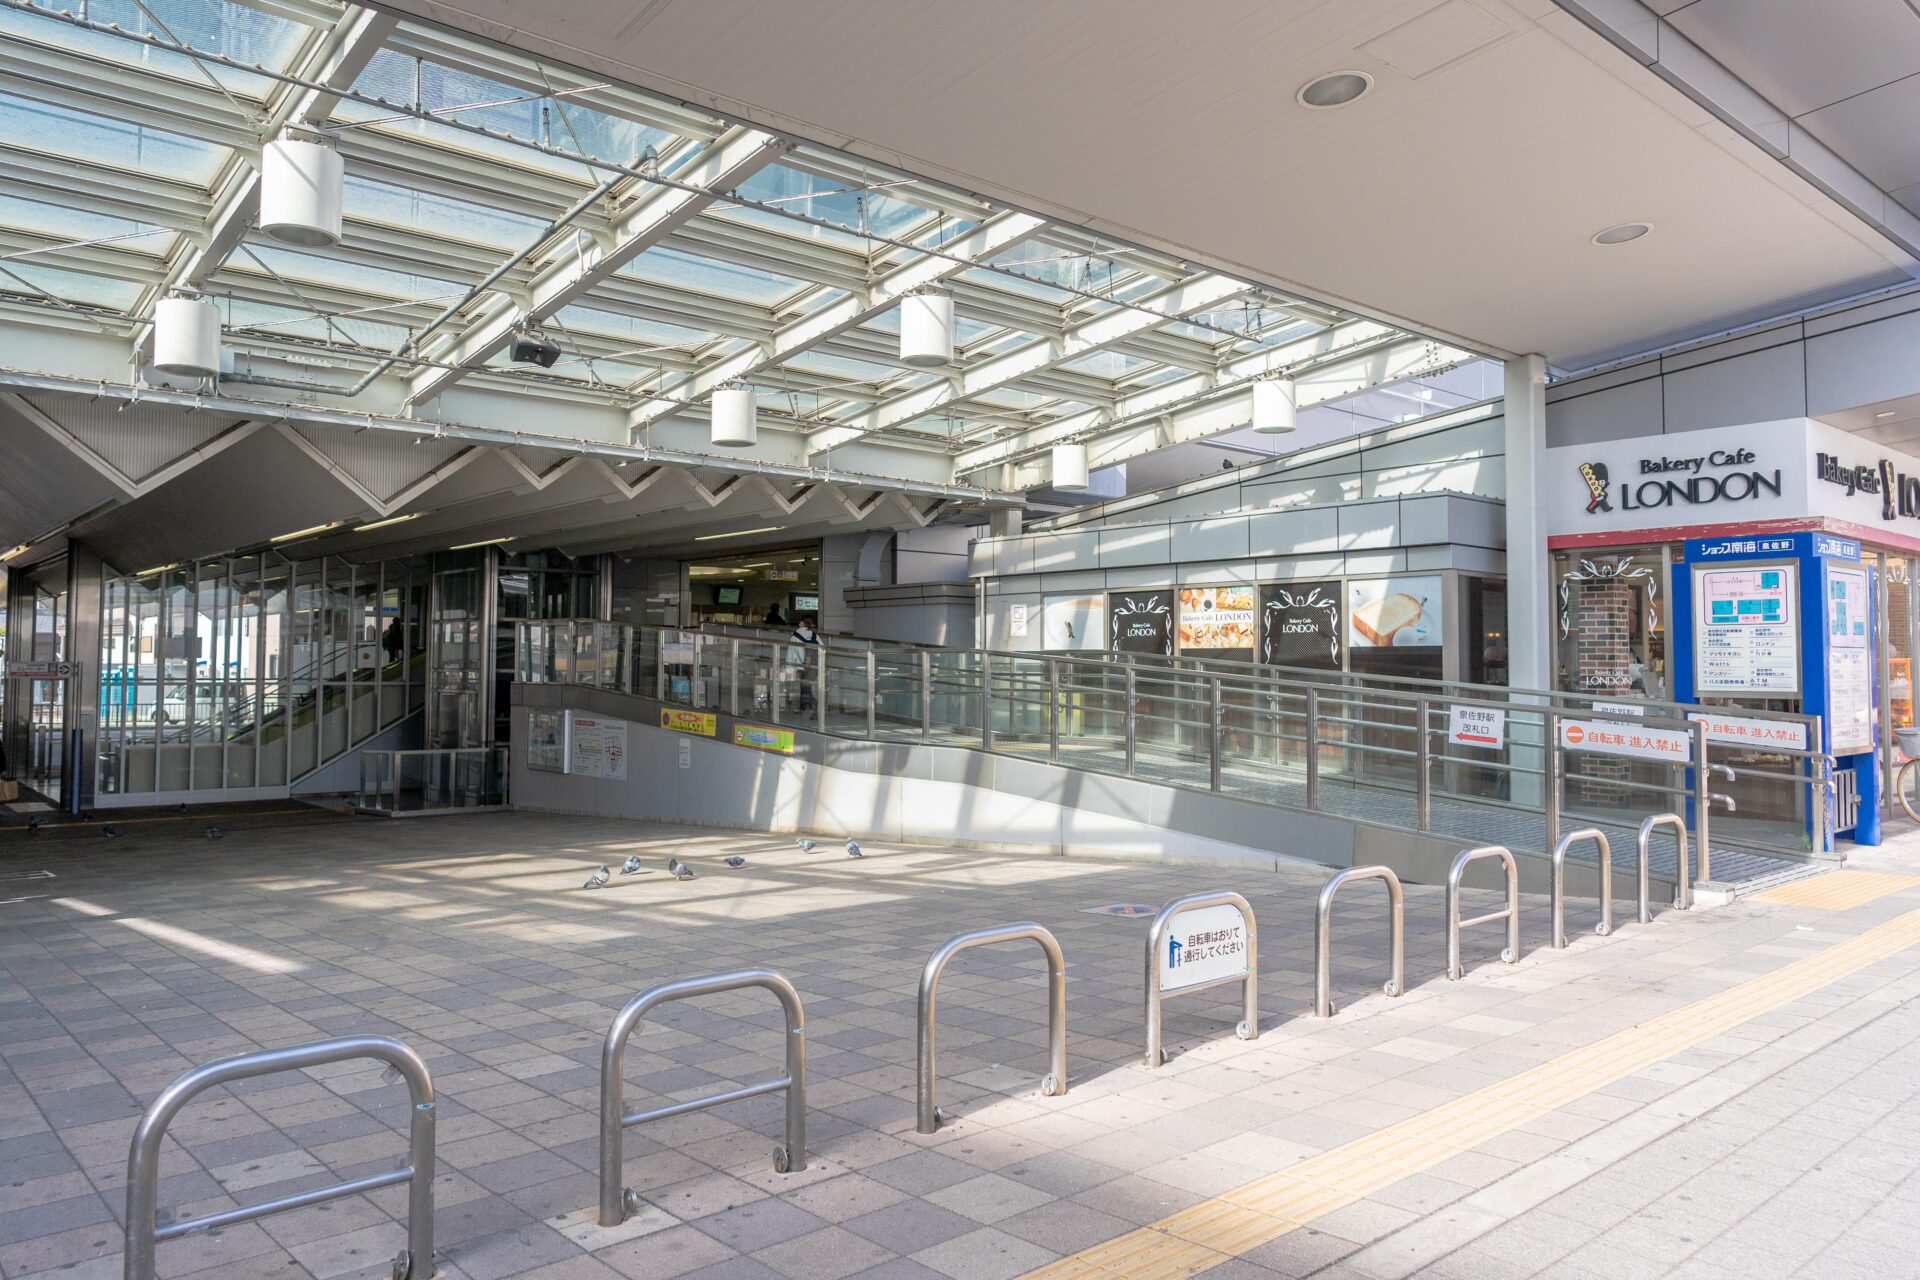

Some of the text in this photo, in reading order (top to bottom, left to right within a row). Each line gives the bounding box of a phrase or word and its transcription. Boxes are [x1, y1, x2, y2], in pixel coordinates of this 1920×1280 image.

[1640, 448, 1756, 475] Bakery Cafe
[1621, 469, 1782, 511] LONDON
[1702, 541, 1790, 556] ショップ南海 泉佐野
[1215, 613, 1251, 621] LONDON
[1127, 628, 1156, 636] LONDON
[1282, 624, 1319, 633] LONDON
[1586, 676, 1632, 686] LONDON
[1459, 711, 1495, 722] 泉佐野駅
[1462, 724, 1489, 734] 改札口
[1713, 724, 1800, 742] 自転車 進入禁止
[1588, 732, 1683, 752] 自転車 進入禁止
[1188, 926, 1240, 947] 自転車はおりて
[1184, 941, 1243, 963] 通行してください
